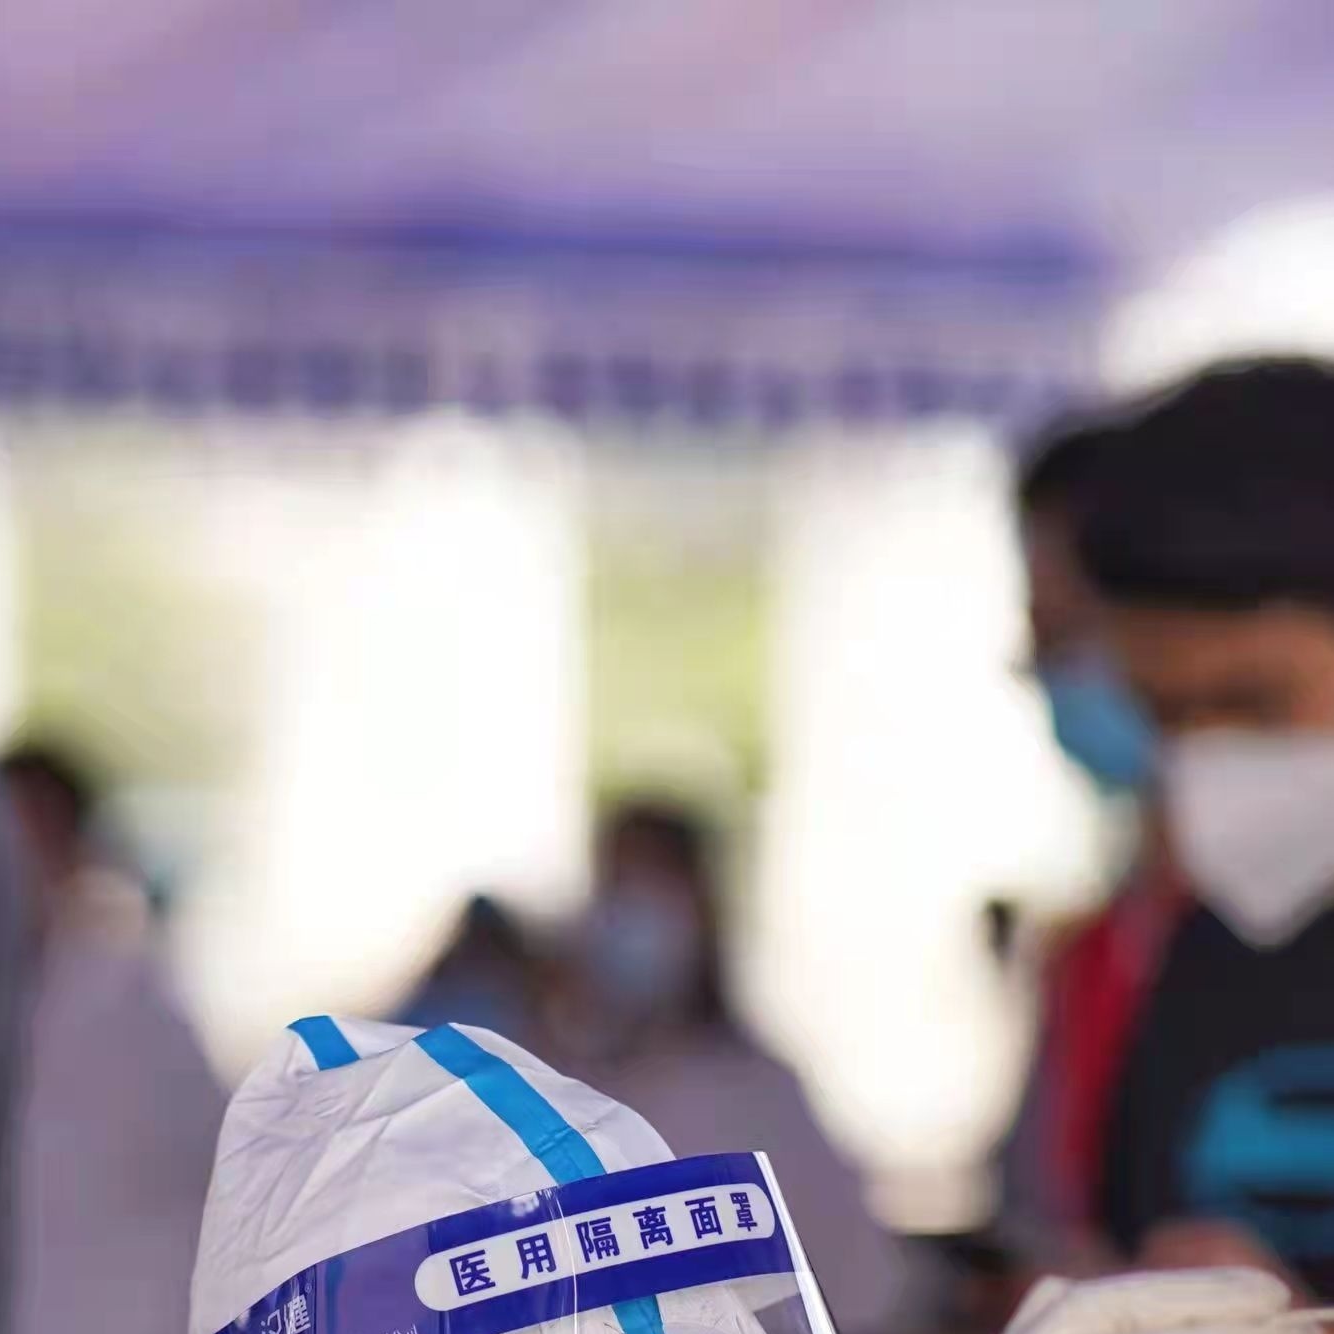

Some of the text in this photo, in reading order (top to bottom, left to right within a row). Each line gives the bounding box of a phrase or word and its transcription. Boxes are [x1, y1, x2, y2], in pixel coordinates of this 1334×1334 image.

[449, 1191, 758, 1296] 医用隔离面罩
